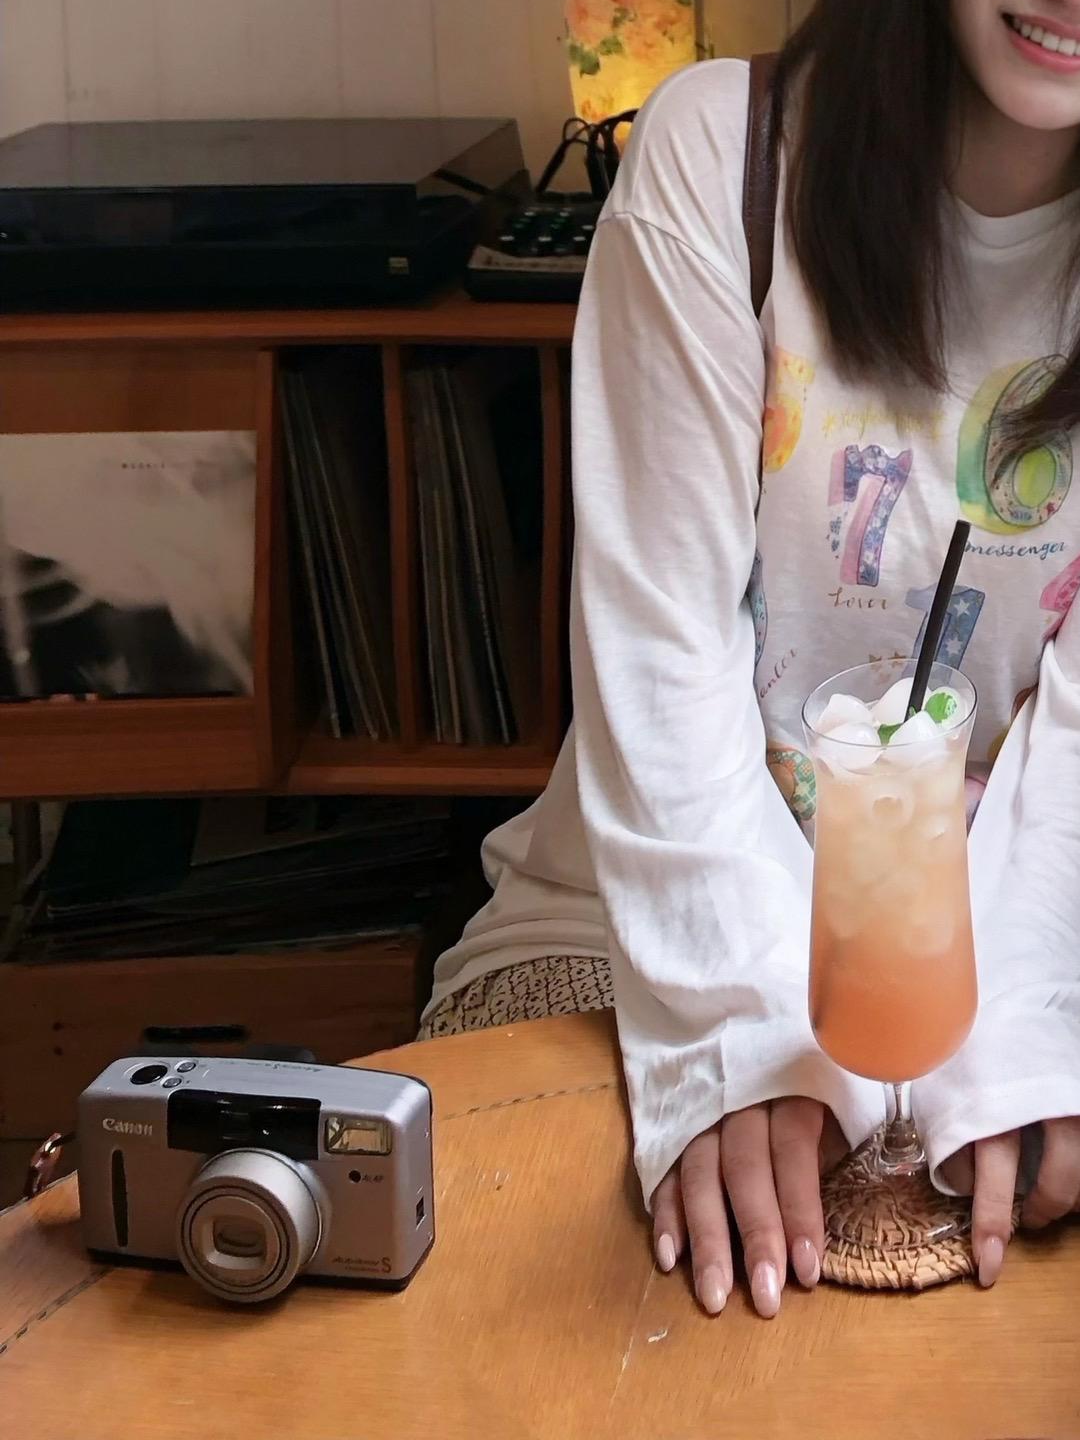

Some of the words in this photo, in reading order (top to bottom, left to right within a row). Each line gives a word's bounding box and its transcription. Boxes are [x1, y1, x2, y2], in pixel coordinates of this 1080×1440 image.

[828, 444, 913, 587] 7
[965, 540, 1065, 561] messenger
[102, 1118, 153, 1136] Canon
